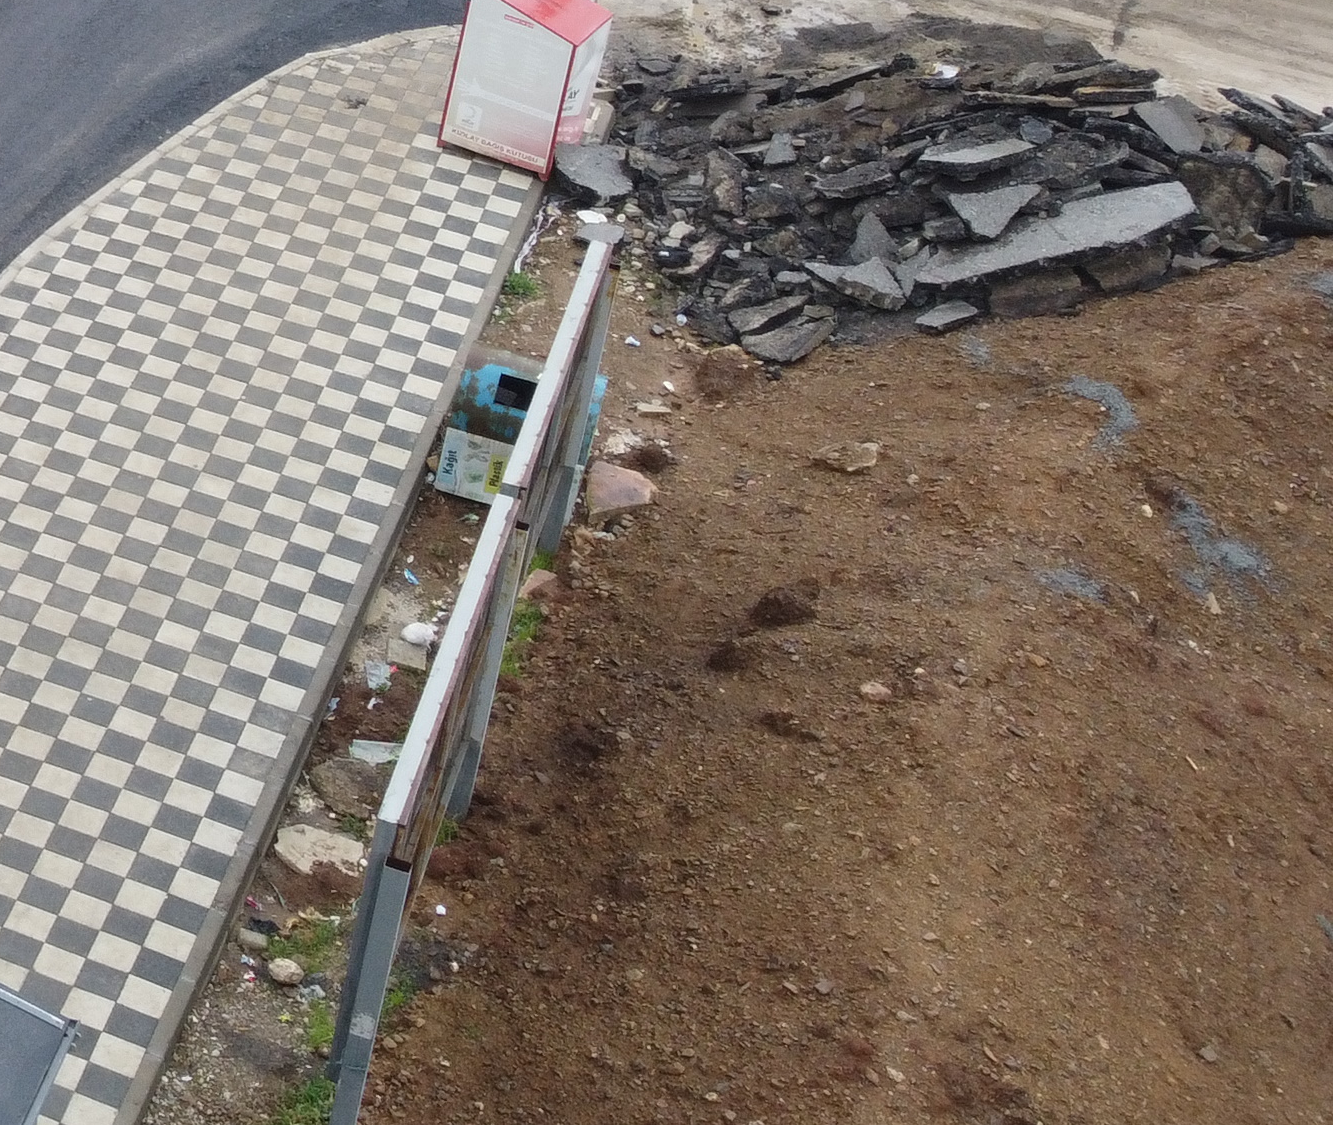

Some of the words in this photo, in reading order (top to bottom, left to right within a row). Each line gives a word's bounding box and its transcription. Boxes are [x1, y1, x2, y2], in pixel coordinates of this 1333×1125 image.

[506, 149, 539, 164] KUTUSU
[442, 450, 458, 475] Kağıt
[488, 460, 504, 488] Plastik
